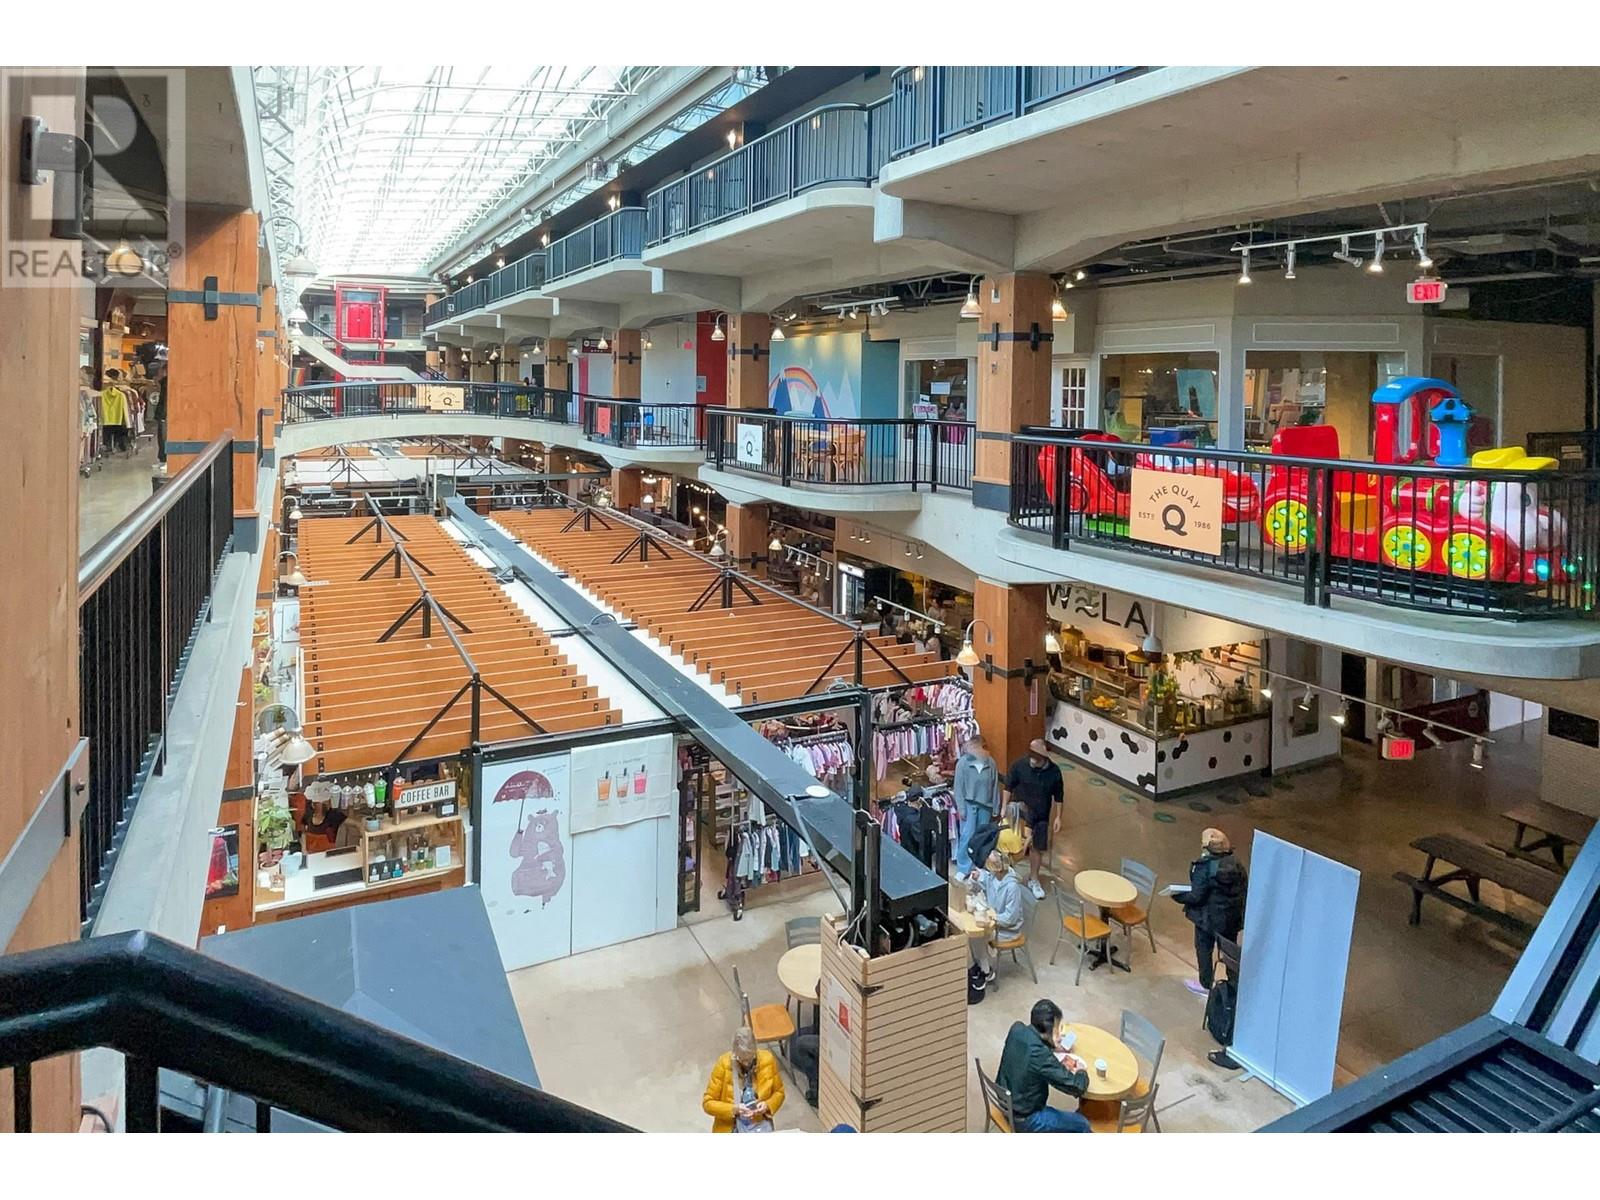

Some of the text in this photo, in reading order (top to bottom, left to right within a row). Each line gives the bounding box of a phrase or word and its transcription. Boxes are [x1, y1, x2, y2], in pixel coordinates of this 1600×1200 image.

[1414, 284, 1440, 300] EXIT
[443, 397, 453, 406] Q
[746, 440, 753, 457] Q
[1149, 485, 1200, 509] THE QUAY
[1162, 504, 1188, 536] Q
[1194, 521, 1211, 530] 1986
[401, 785, 449, 804] COFFEE BAR
